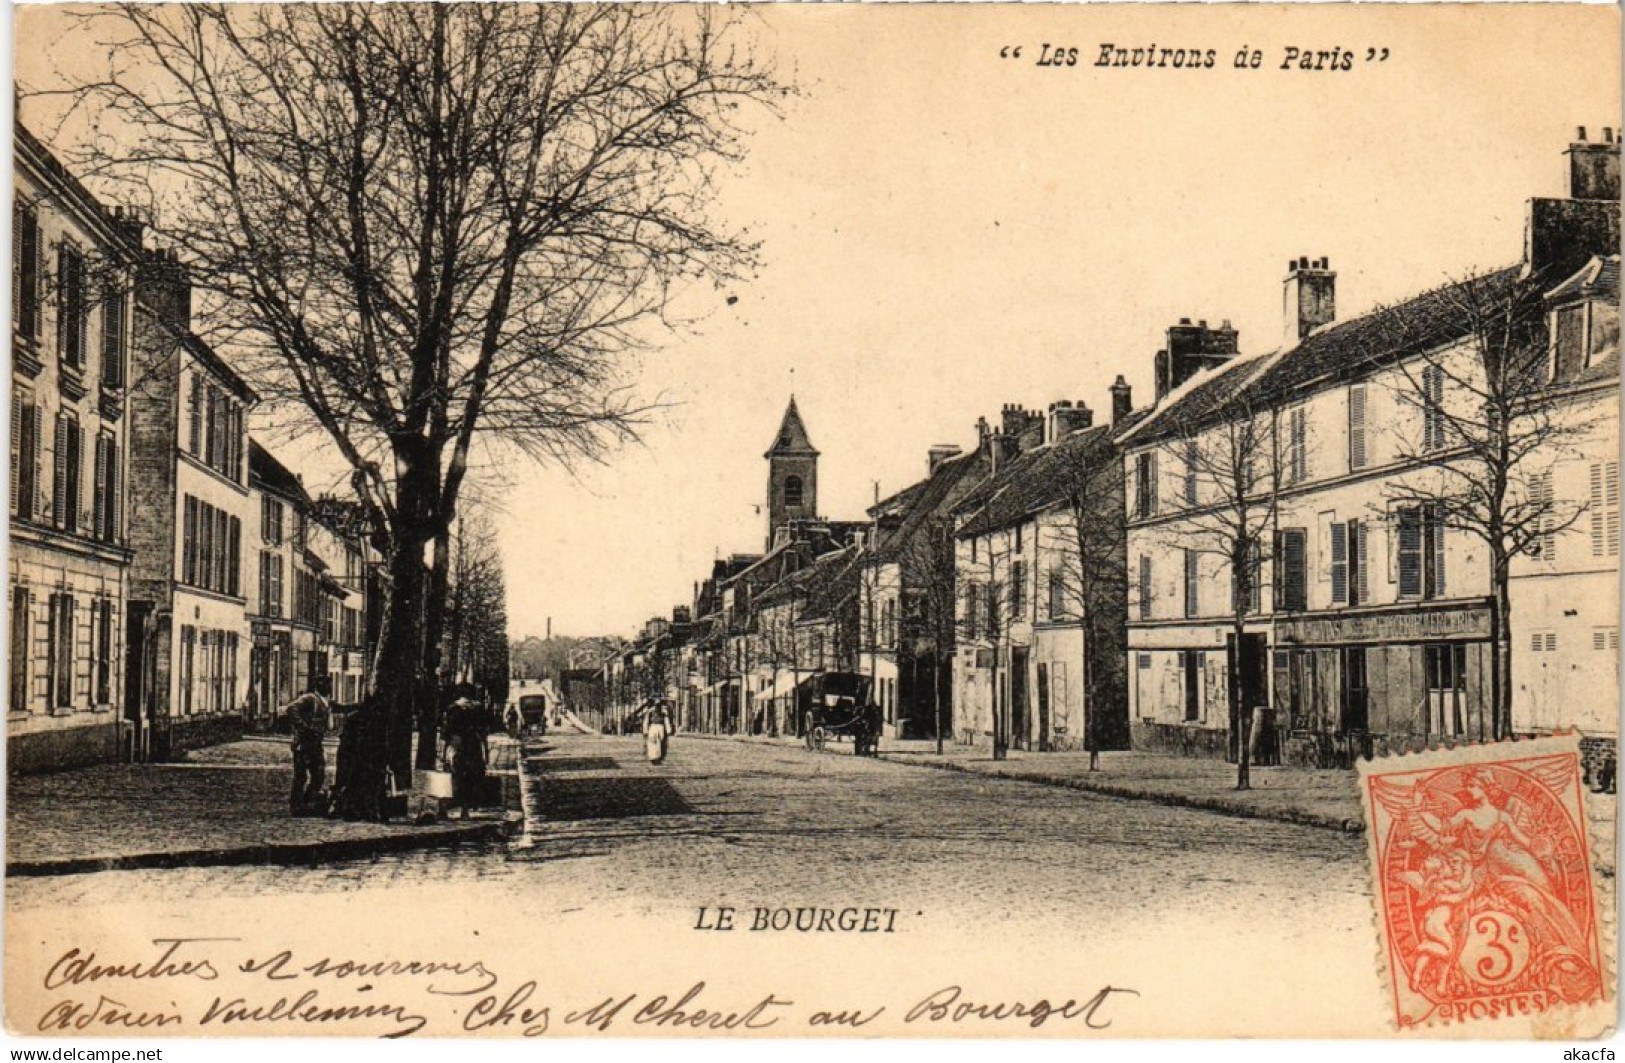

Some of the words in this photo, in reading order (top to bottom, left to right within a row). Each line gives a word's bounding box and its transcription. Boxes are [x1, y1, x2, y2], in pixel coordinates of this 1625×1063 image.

[1035, 42, 1079, 68] Les
[1093, 43, 1217, 69] Environs
[1232, 43, 1263, 69] de
[1279, 45, 1355, 72] Paris
[693, 906, 736, 932] LE
[749, 906, 900, 933] BOURGET
[239, 950, 299, 980] et
[808, 1005, 886, 1027] au
[904, 985, 1141, 1029] Bourget
[1456, 992, 1548, 1024] POSTES
